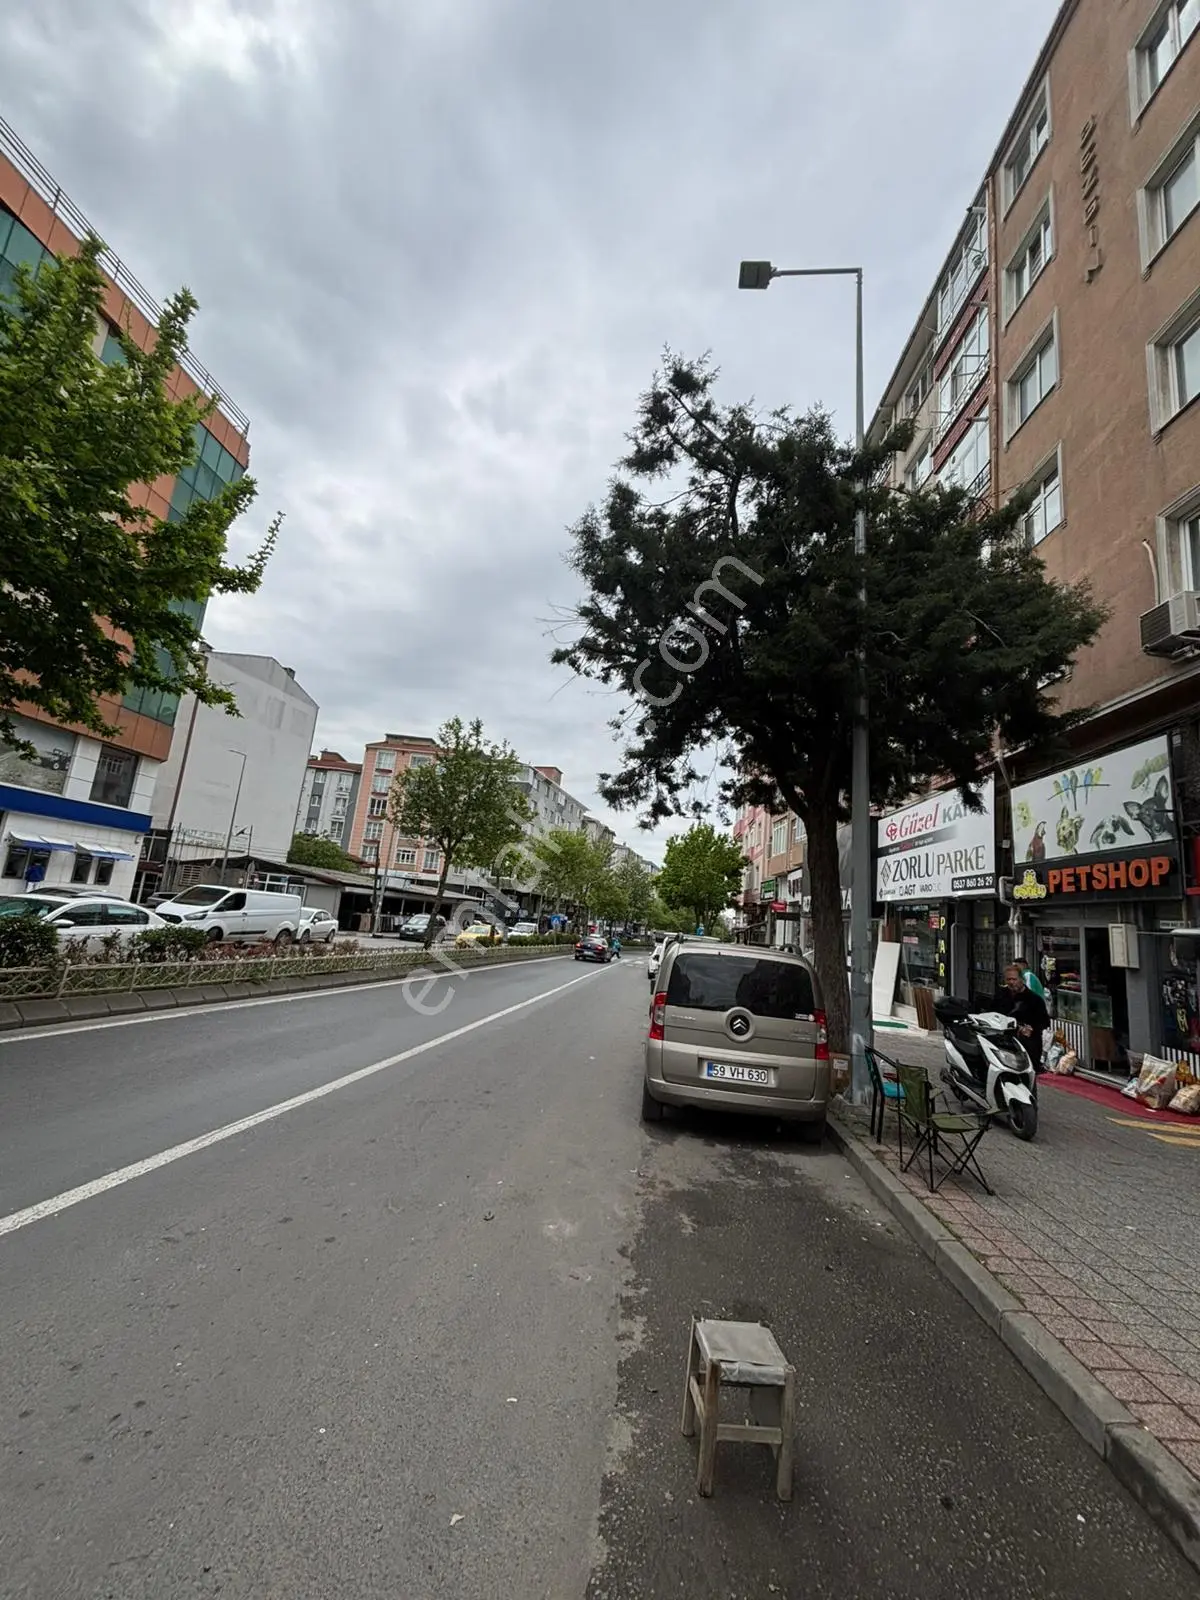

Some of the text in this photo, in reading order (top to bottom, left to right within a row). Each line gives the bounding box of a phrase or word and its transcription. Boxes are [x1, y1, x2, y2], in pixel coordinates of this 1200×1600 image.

[900, 802, 939, 838] Güzel
[892, 852, 935, 882] ZORLU
[937, 845, 986, 876] PARKE
[1048, 857, 1170, 893] PETSHOP
[713, 1065, 766, 1082] 59 VH 630
